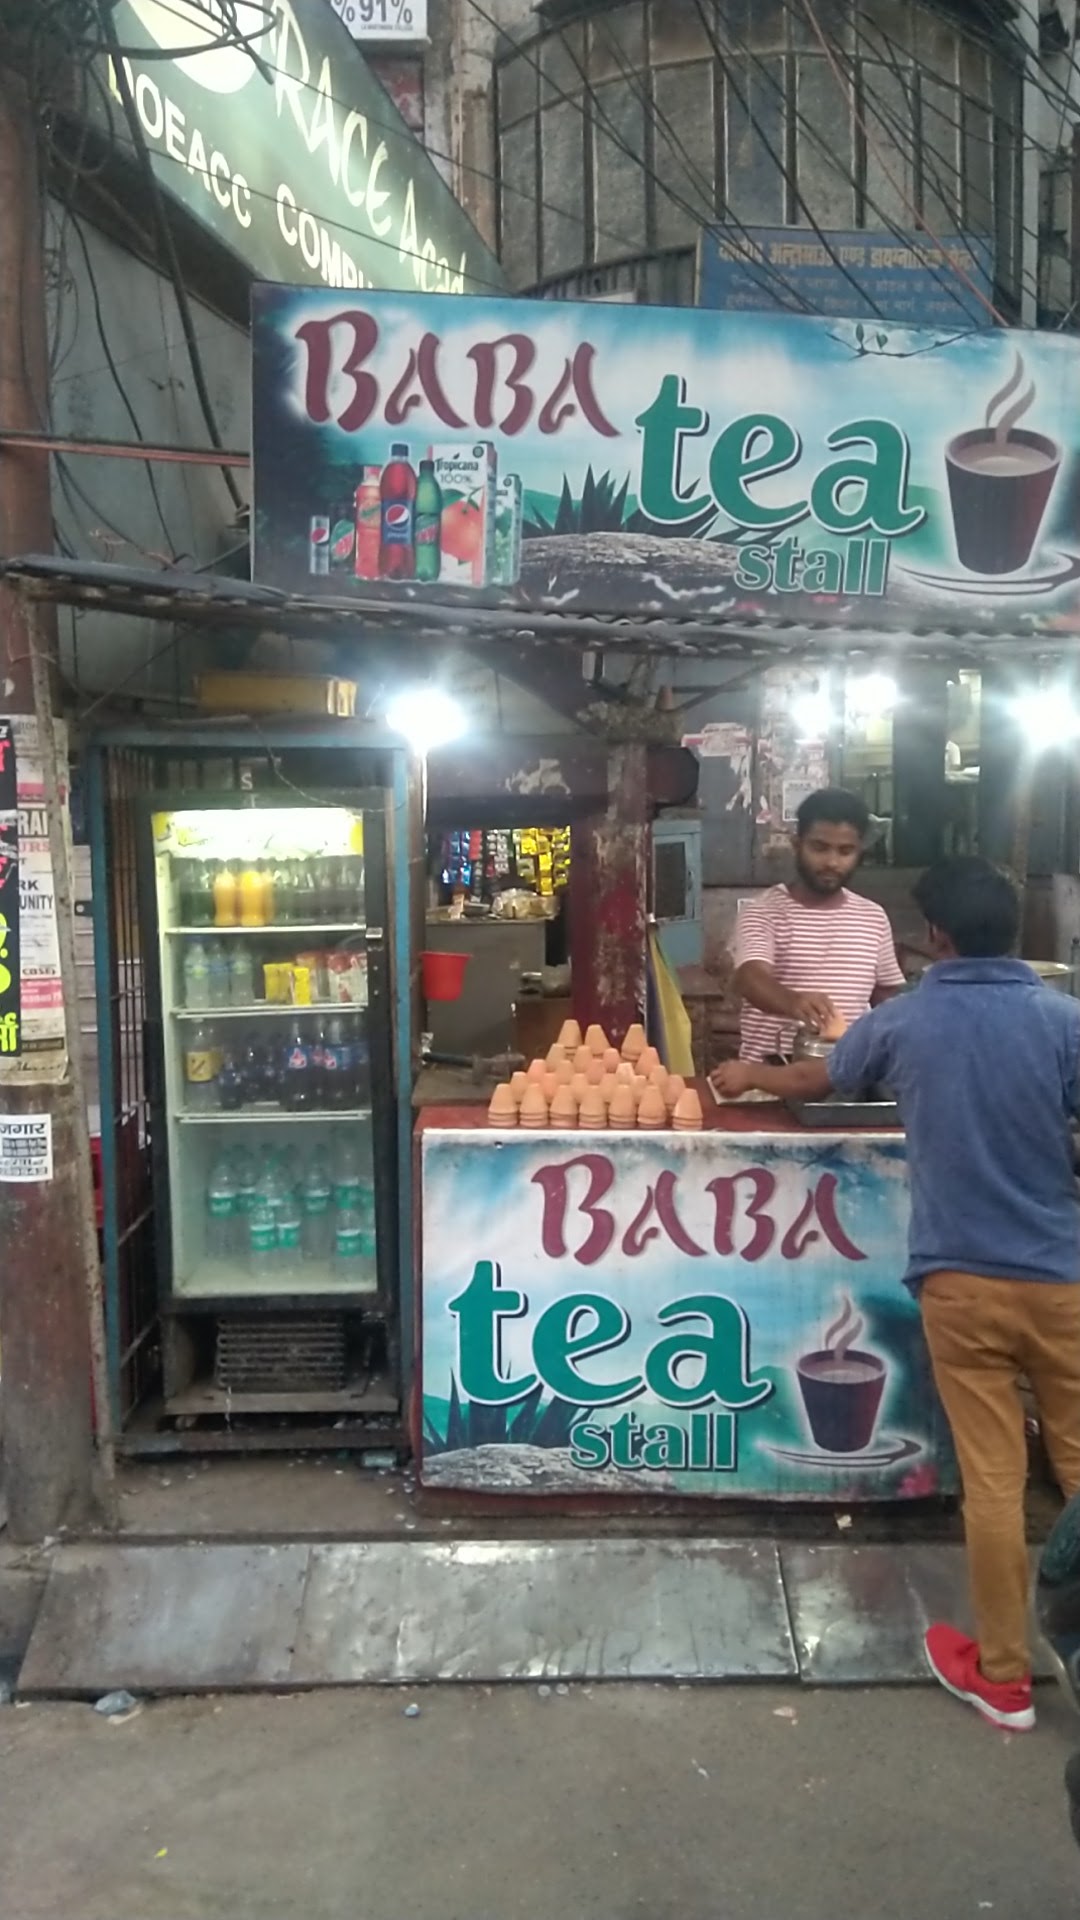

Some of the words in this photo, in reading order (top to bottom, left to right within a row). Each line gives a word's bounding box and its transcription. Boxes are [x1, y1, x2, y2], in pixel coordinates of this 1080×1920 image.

[296, 310, 621, 437] BABA
[435, 457, 479, 472] Tropicana
[633, 374, 926, 538] tea
[733, 537, 891, 597] stall
[530, 1153, 869, 1266] BABA
[447, 1260, 775, 1409] tea
[569, 1411, 739, 1473] stall
